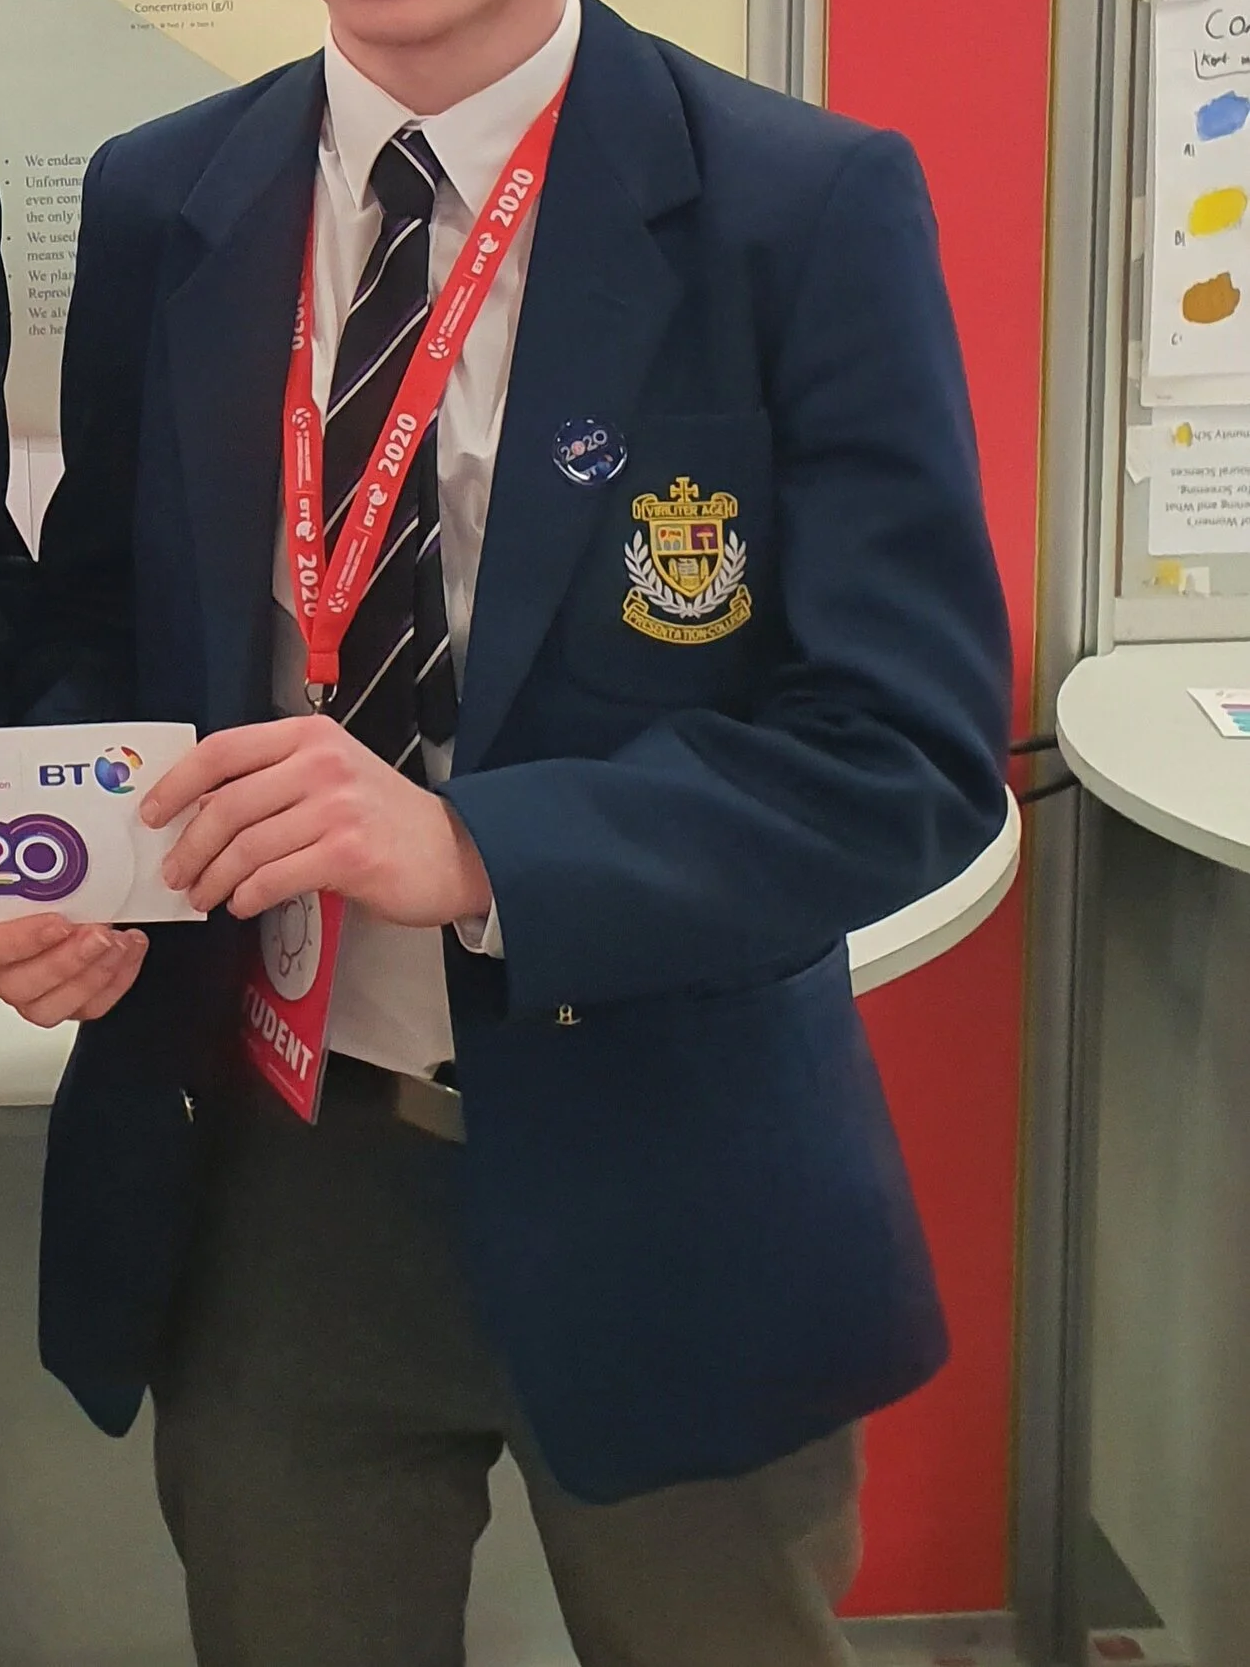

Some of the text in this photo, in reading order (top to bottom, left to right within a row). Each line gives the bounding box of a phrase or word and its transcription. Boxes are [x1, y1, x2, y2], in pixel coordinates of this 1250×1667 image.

[132, 0, 233, 15] Concentration (g/l)
[490, 168, 534, 228] 2020
[378, 413, 417, 478] 2020
[39, 764, 91, 787] BT
[245, 988, 314, 1081] TUDENT
